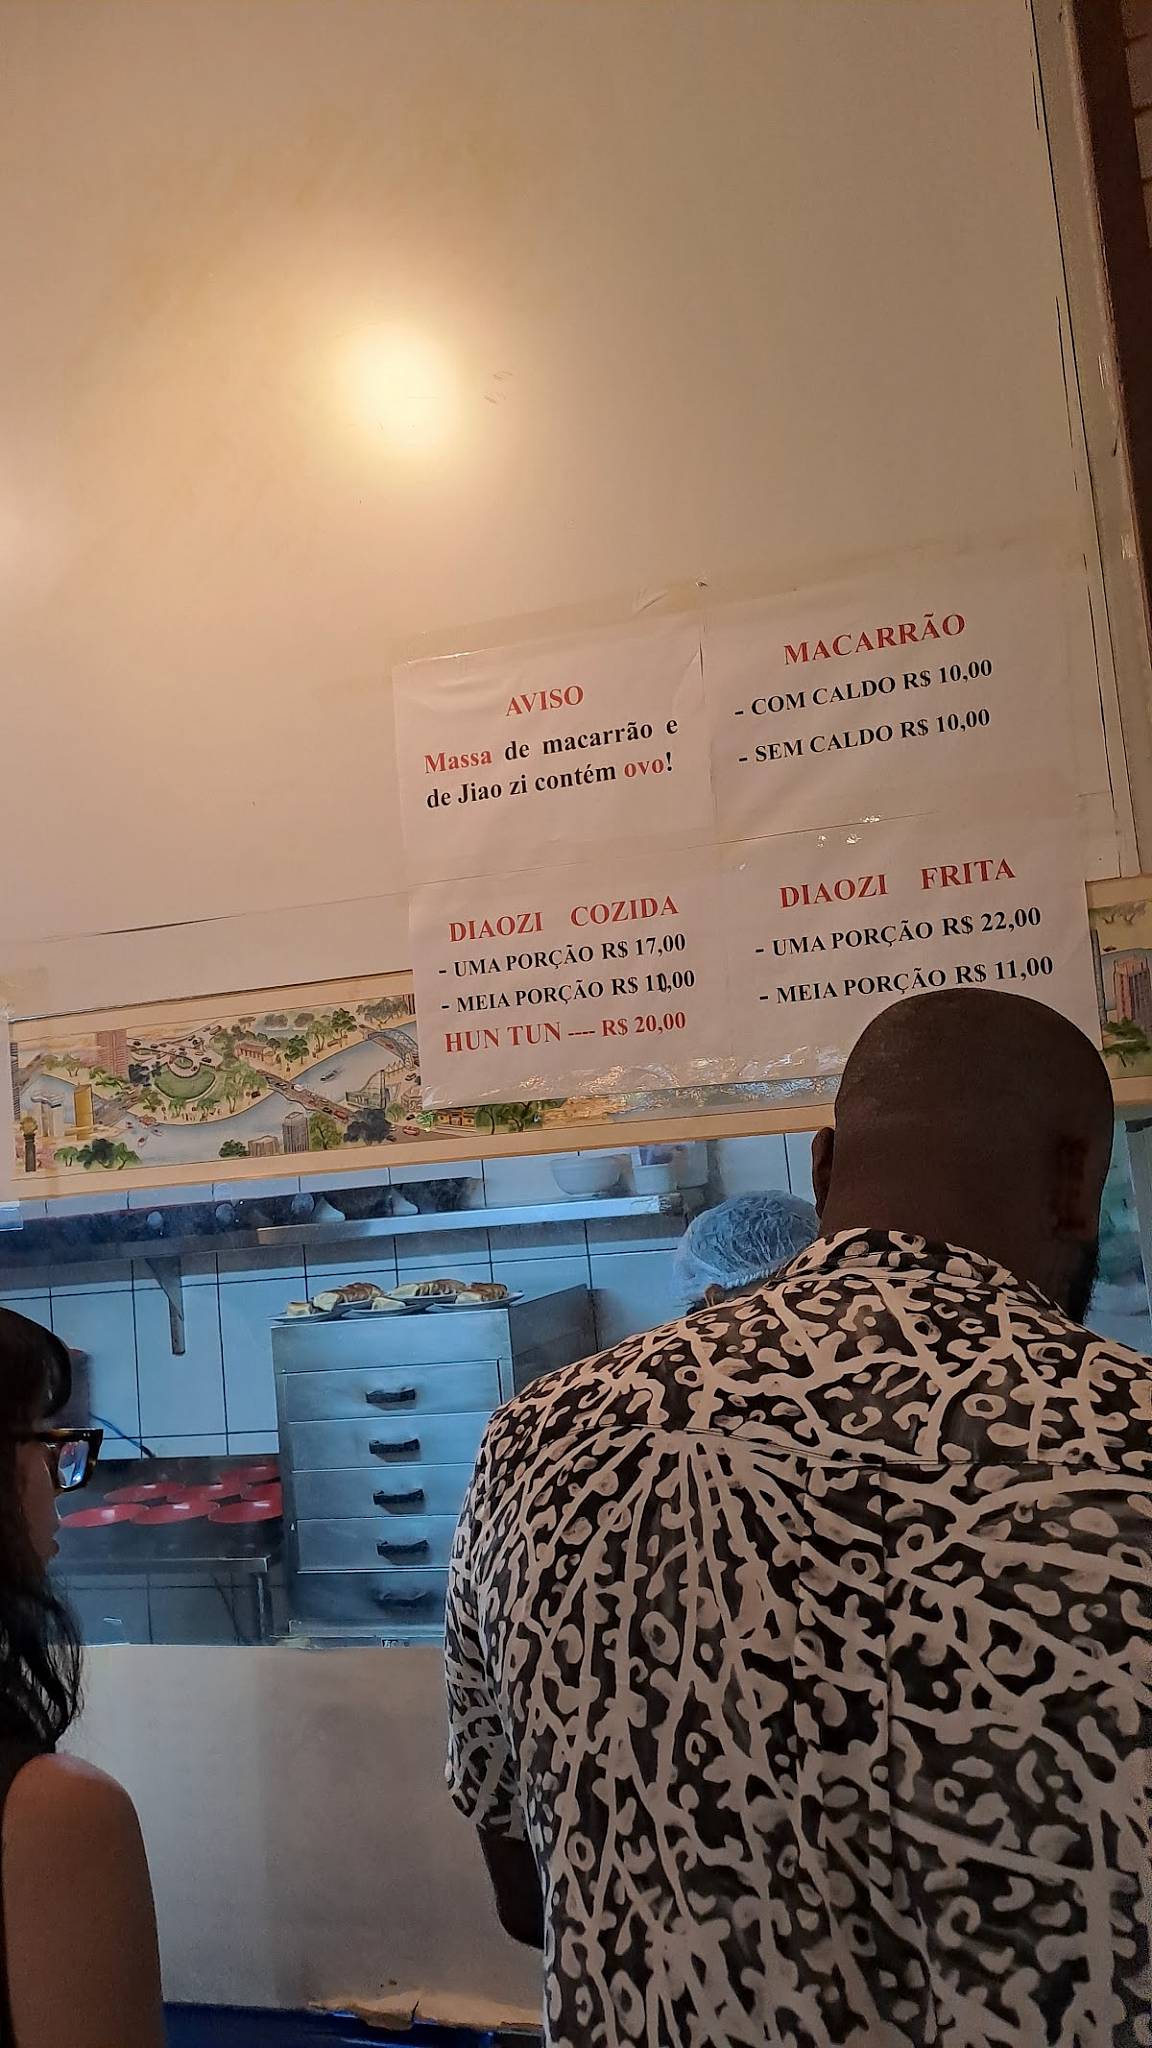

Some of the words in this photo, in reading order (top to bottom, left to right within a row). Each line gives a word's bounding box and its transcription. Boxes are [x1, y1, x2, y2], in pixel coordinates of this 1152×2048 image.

[784, 613, 965, 665] MACARRÃO
[506, 686, 583, 716] AVISO
[751, 692, 806, 715] COM
[813, 677, 895, 705] CALDO
[902, 670, 931, 689] R$
[939, 660, 992, 683] 10,00
[424, 751, 492, 773] Massa
[505, 741, 529, 760] de
[543, 722, 652, 754] macarrão
[667, 720, 677, 734] e
[756, 739, 803, 762] SEM
[810, 725, 893, 752] CALDO
[899, 719, 928, 738] R$
[936, 709, 989, 732] 10,00
[427, 789, 451, 808] de
[458, 782, 501, 803] Jiao
[509, 774, 527, 795] zi
[535, 764, 616, 791] contém
[624, 752, 672, 777] ovo!
[779, 874, 888, 908] DIAOZI
[921, 859, 1016, 889] FRITA
[449, 912, 544, 942] DIAOZI
[571, 896, 679, 926] COZIDA
[773, 936, 826, 956] UMA
[832, 920, 933, 949] PORÇÃO
[941, 916, 973, 936] R$
[981, 907, 1040, 932] 22,00
[454, 958, 501, 977] UMA
[506, 945, 593, 971] PORÇÃO
[601, 941, 628, 959] R$
[635, 934, 685, 957] 17,00
[776, 982, 838, 1003] MEIA
[844, 968, 946, 996] PORÇÃO
[954, 964, 986, 983] R$
[995, 956, 1053, 981] 11,00
[457, 993, 510, 1012] MEIA
[515, 980, 603, 1006] PORÇÃO
[611, 977, 638, 995] R$
[445, 1028, 499, 1052] HUN
[507, 1022, 560, 1046] TUN
[602, 1019, 628, 1036] R$
[635, 1012, 685, 1034] 20,00
